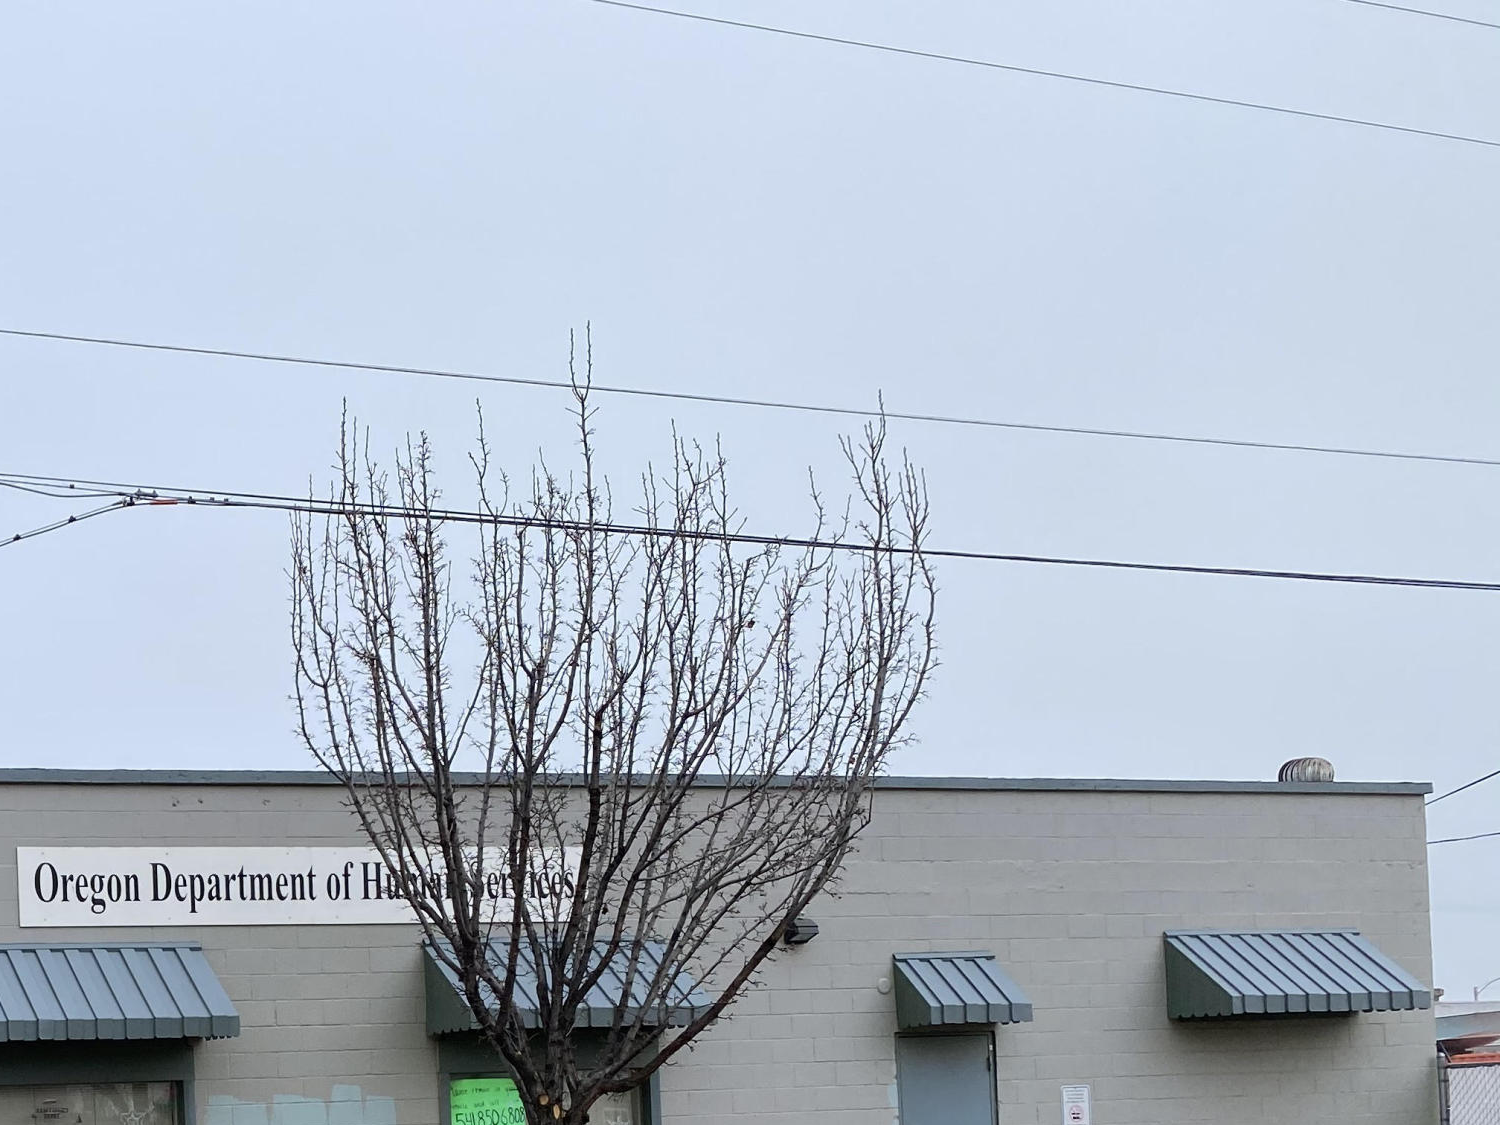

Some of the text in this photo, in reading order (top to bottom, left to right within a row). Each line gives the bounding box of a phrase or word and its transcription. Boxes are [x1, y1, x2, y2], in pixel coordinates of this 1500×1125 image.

[34, 861, 141, 914] Oregon
[149, 861, 317, 914] Department
[326, 860, 354, 901] of
